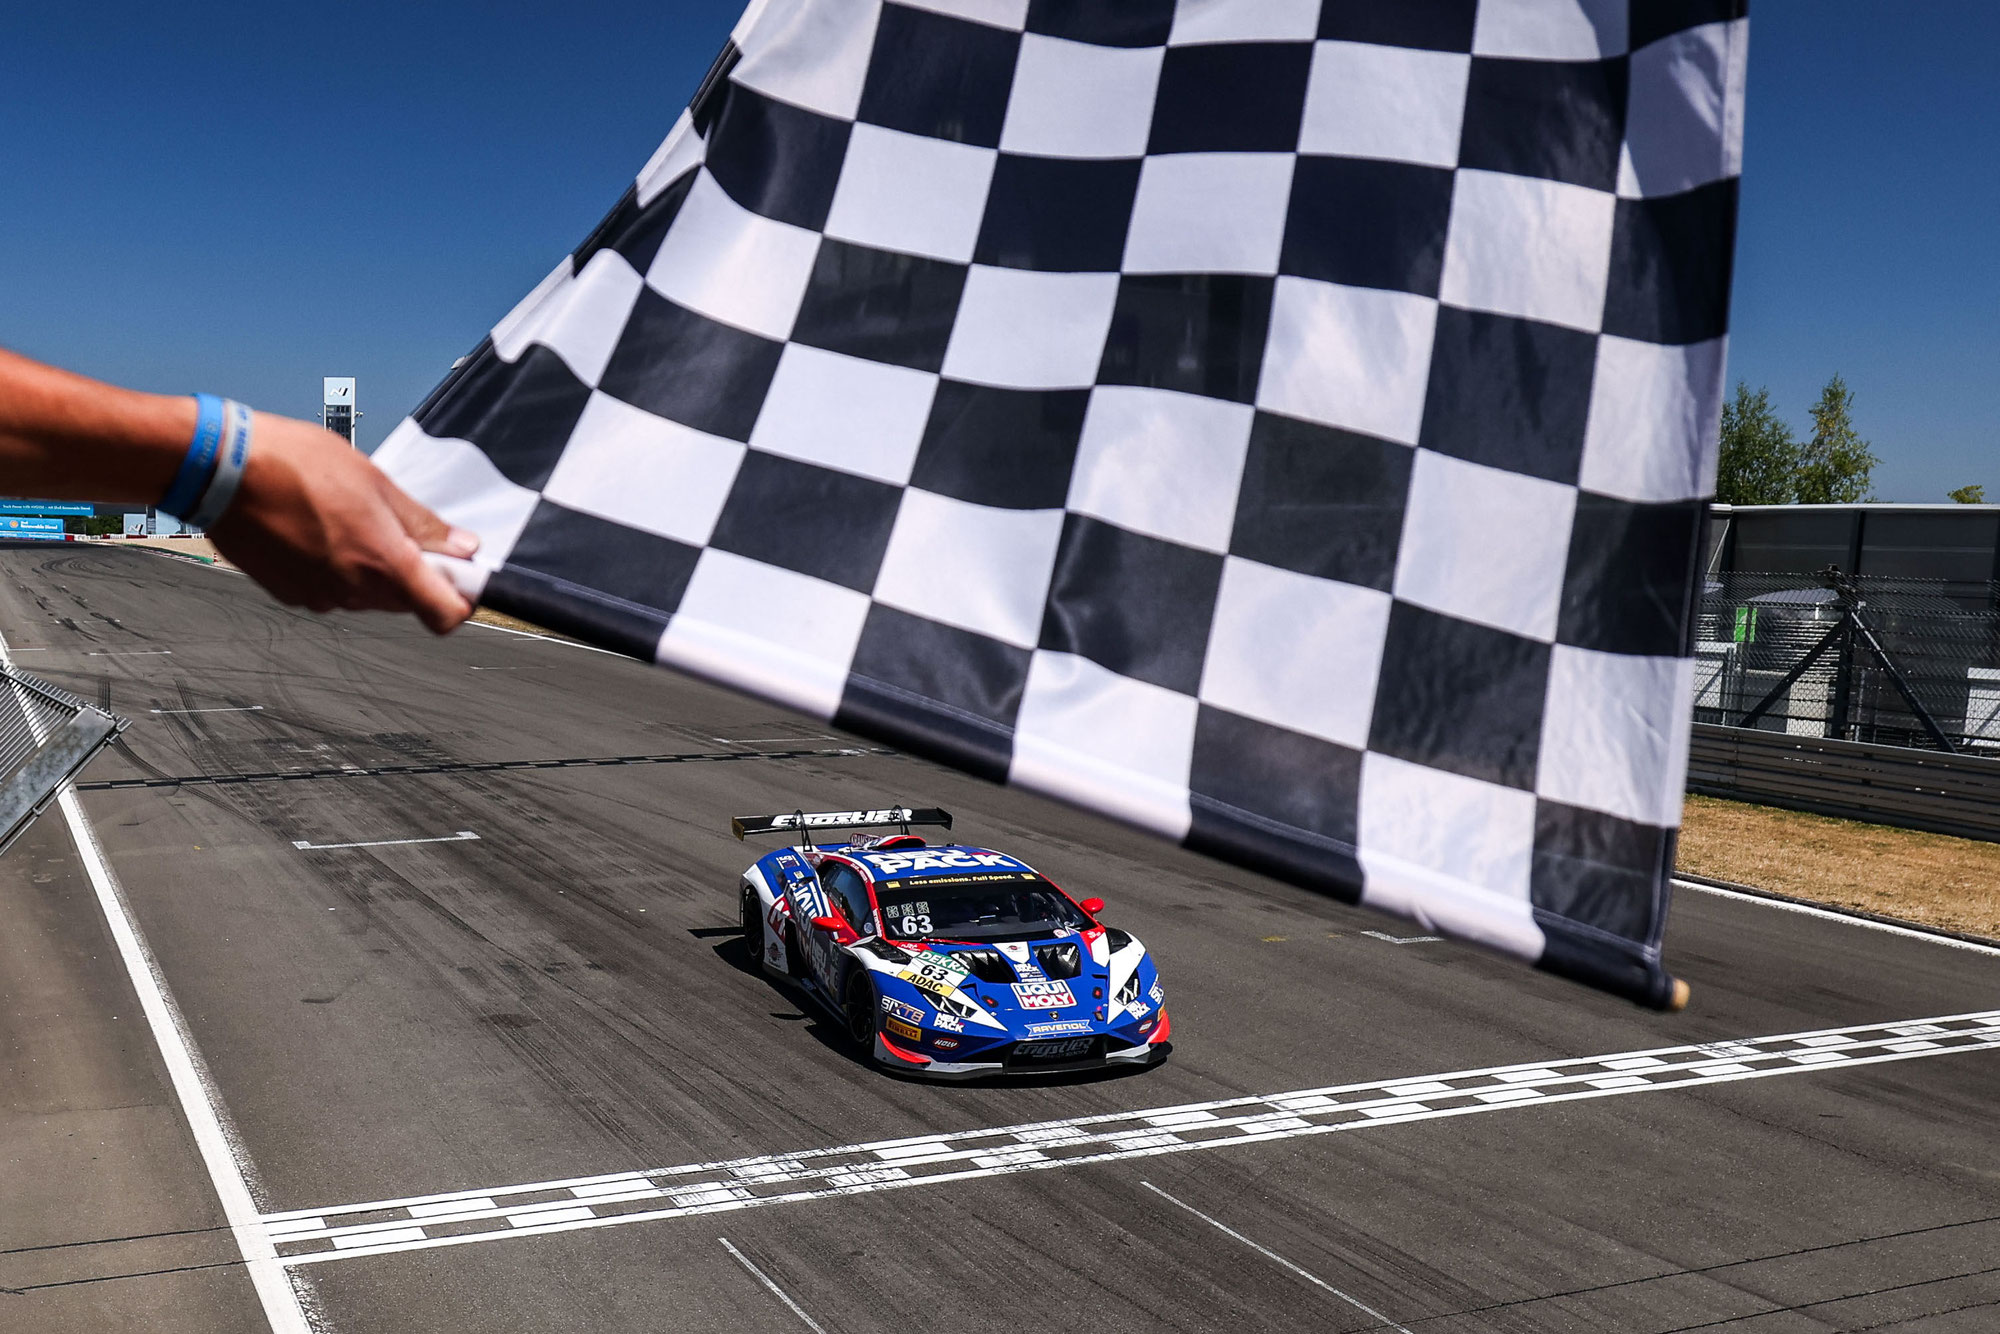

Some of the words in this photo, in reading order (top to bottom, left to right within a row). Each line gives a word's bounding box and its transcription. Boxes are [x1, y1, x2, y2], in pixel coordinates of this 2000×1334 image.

[863, 850, 966, 864] NEU
[878, 854, 1018, 875] PACK
[902, 914, 934, 935] 63
[918, 951, 967, 975] DEKRA
[920, 965, 949, 981] 63
[907, 974, 944, 992] ADAC
[1015, 982, 1067, 996] LIQUI
[1021, 992, 1075, 1008] MOLY
[933, 1018, 965, 1033] PACK
[937, 1012, 960, 1024] NEU
[1032, 1022, 1085, 1034] RAVENOL
